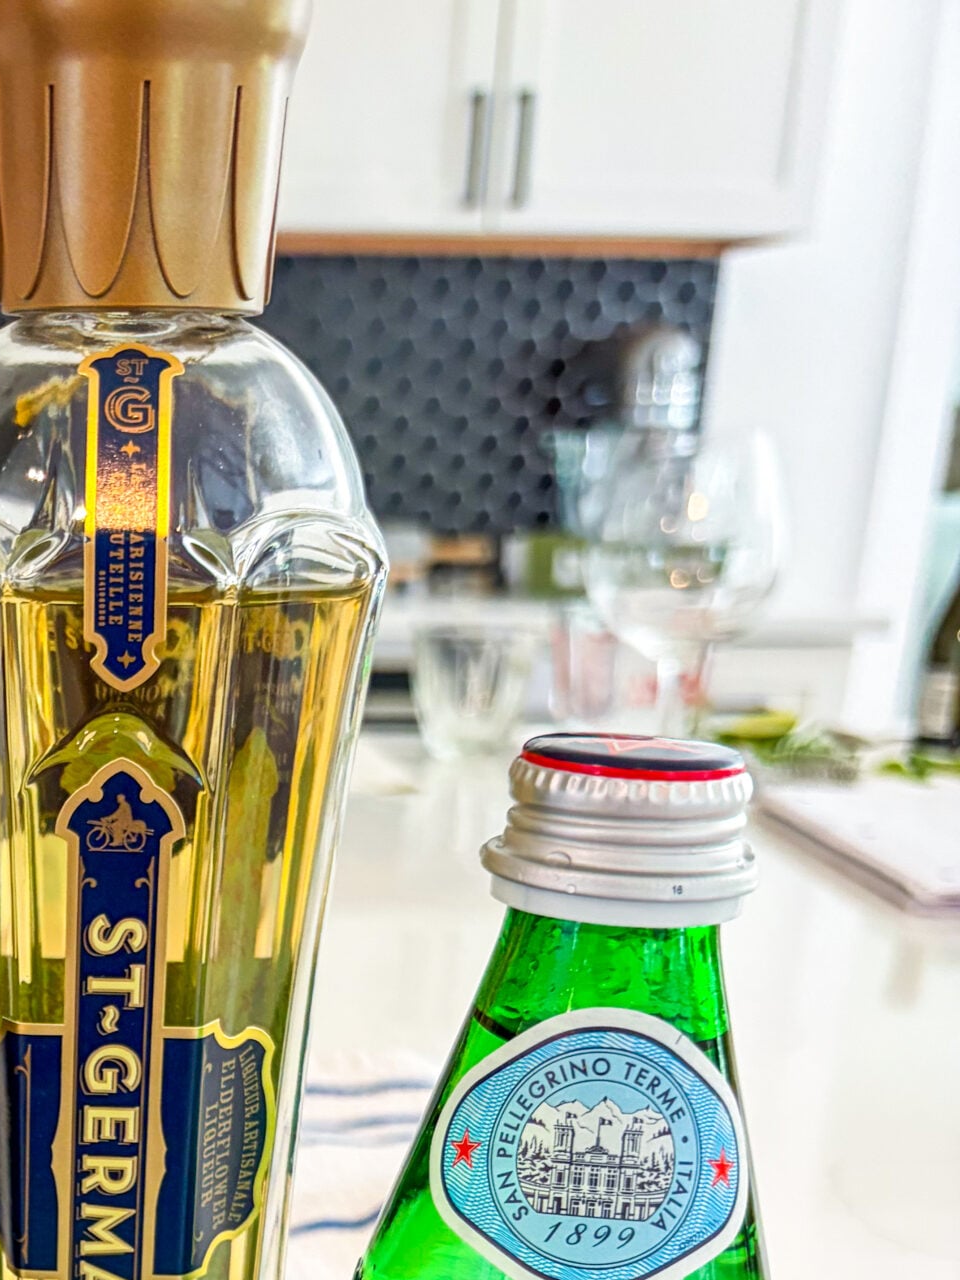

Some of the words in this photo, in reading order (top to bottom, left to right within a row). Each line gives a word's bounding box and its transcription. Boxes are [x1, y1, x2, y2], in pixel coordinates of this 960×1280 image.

[115, 358, 149, 376] ST
[104, 385, 156, 434] G
[496, 1057, 612, 1159] PELLEGRINO
[623, 1061, 687, 1124] TERME
[200, 1101, 219, 1208] LIQUEUR
[211, 1056, 237, 1231] ELDERFLOWER
[497, 1170, 529, 1222] SAN
[650, 1160, 694, 1232] ITALIA
[543, 1221, 637, 1250] 1899
